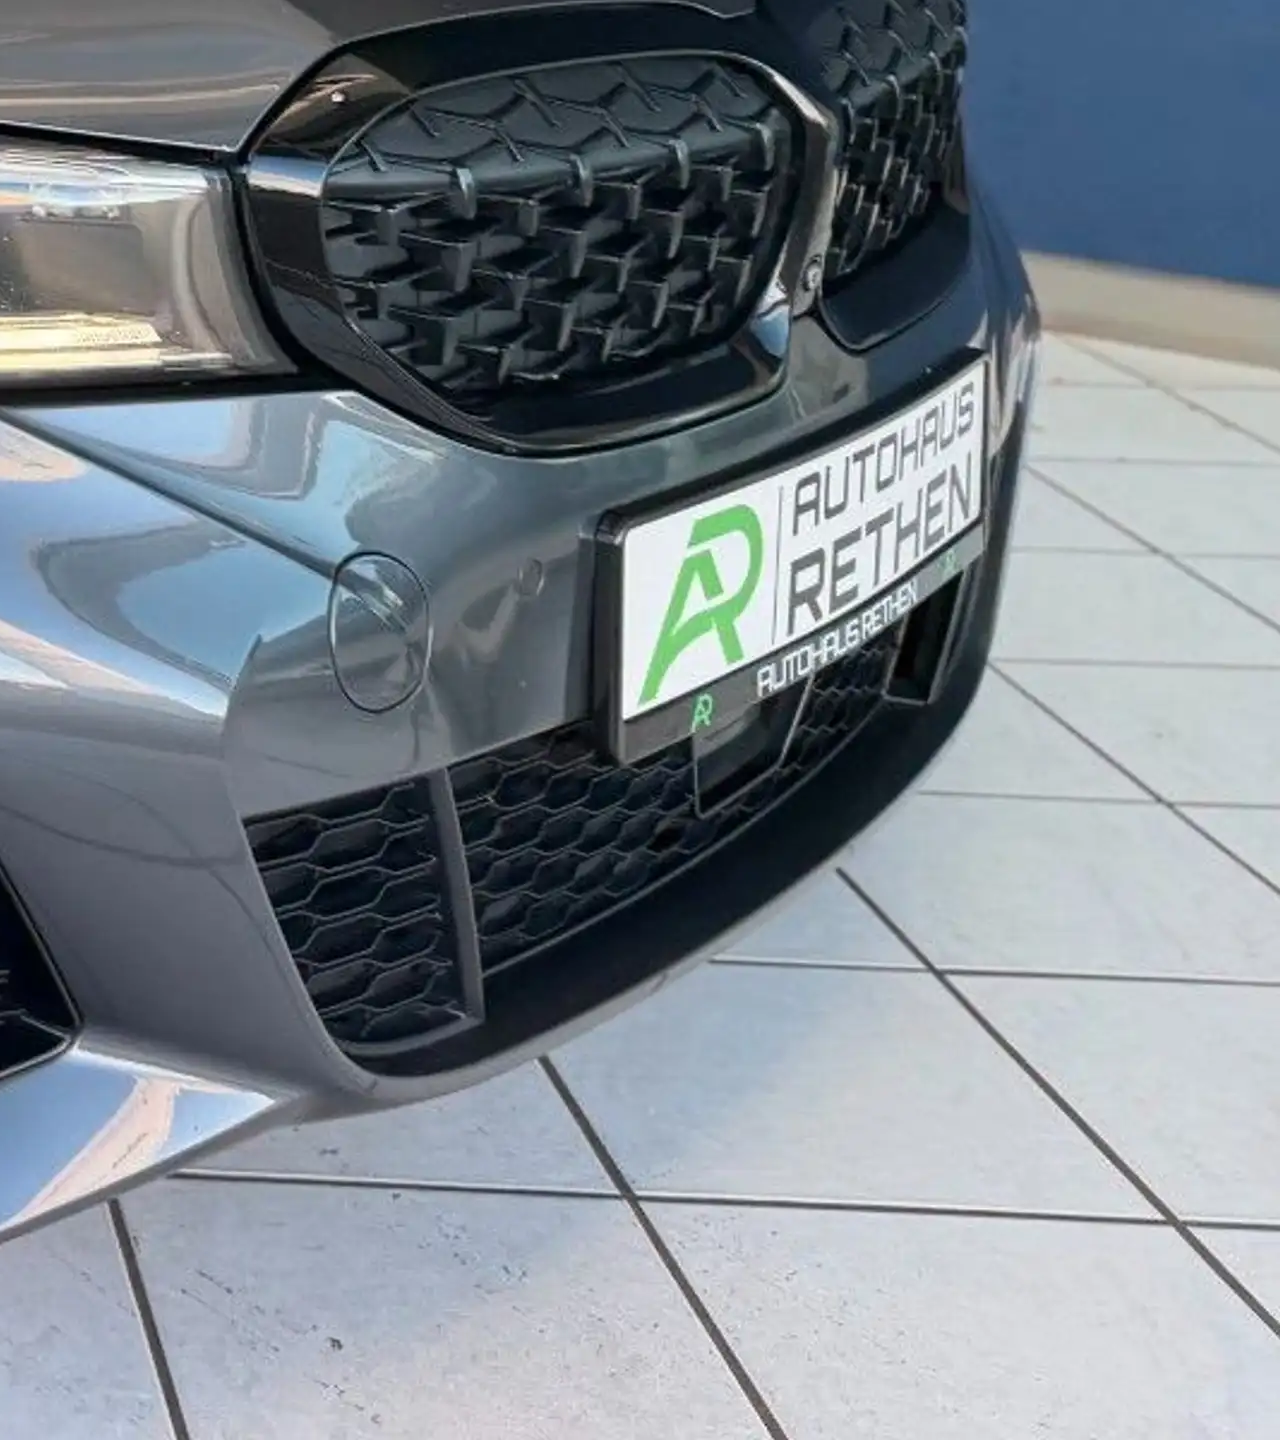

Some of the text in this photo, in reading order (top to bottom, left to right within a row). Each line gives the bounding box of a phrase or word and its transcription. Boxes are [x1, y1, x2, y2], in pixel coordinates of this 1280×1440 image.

[792, 382, 975, 537] AUTOHAUS
[786, 452, 973, 636] RETHEN
[756, 580, 918, 698] AUTOHAUS RETHEN
